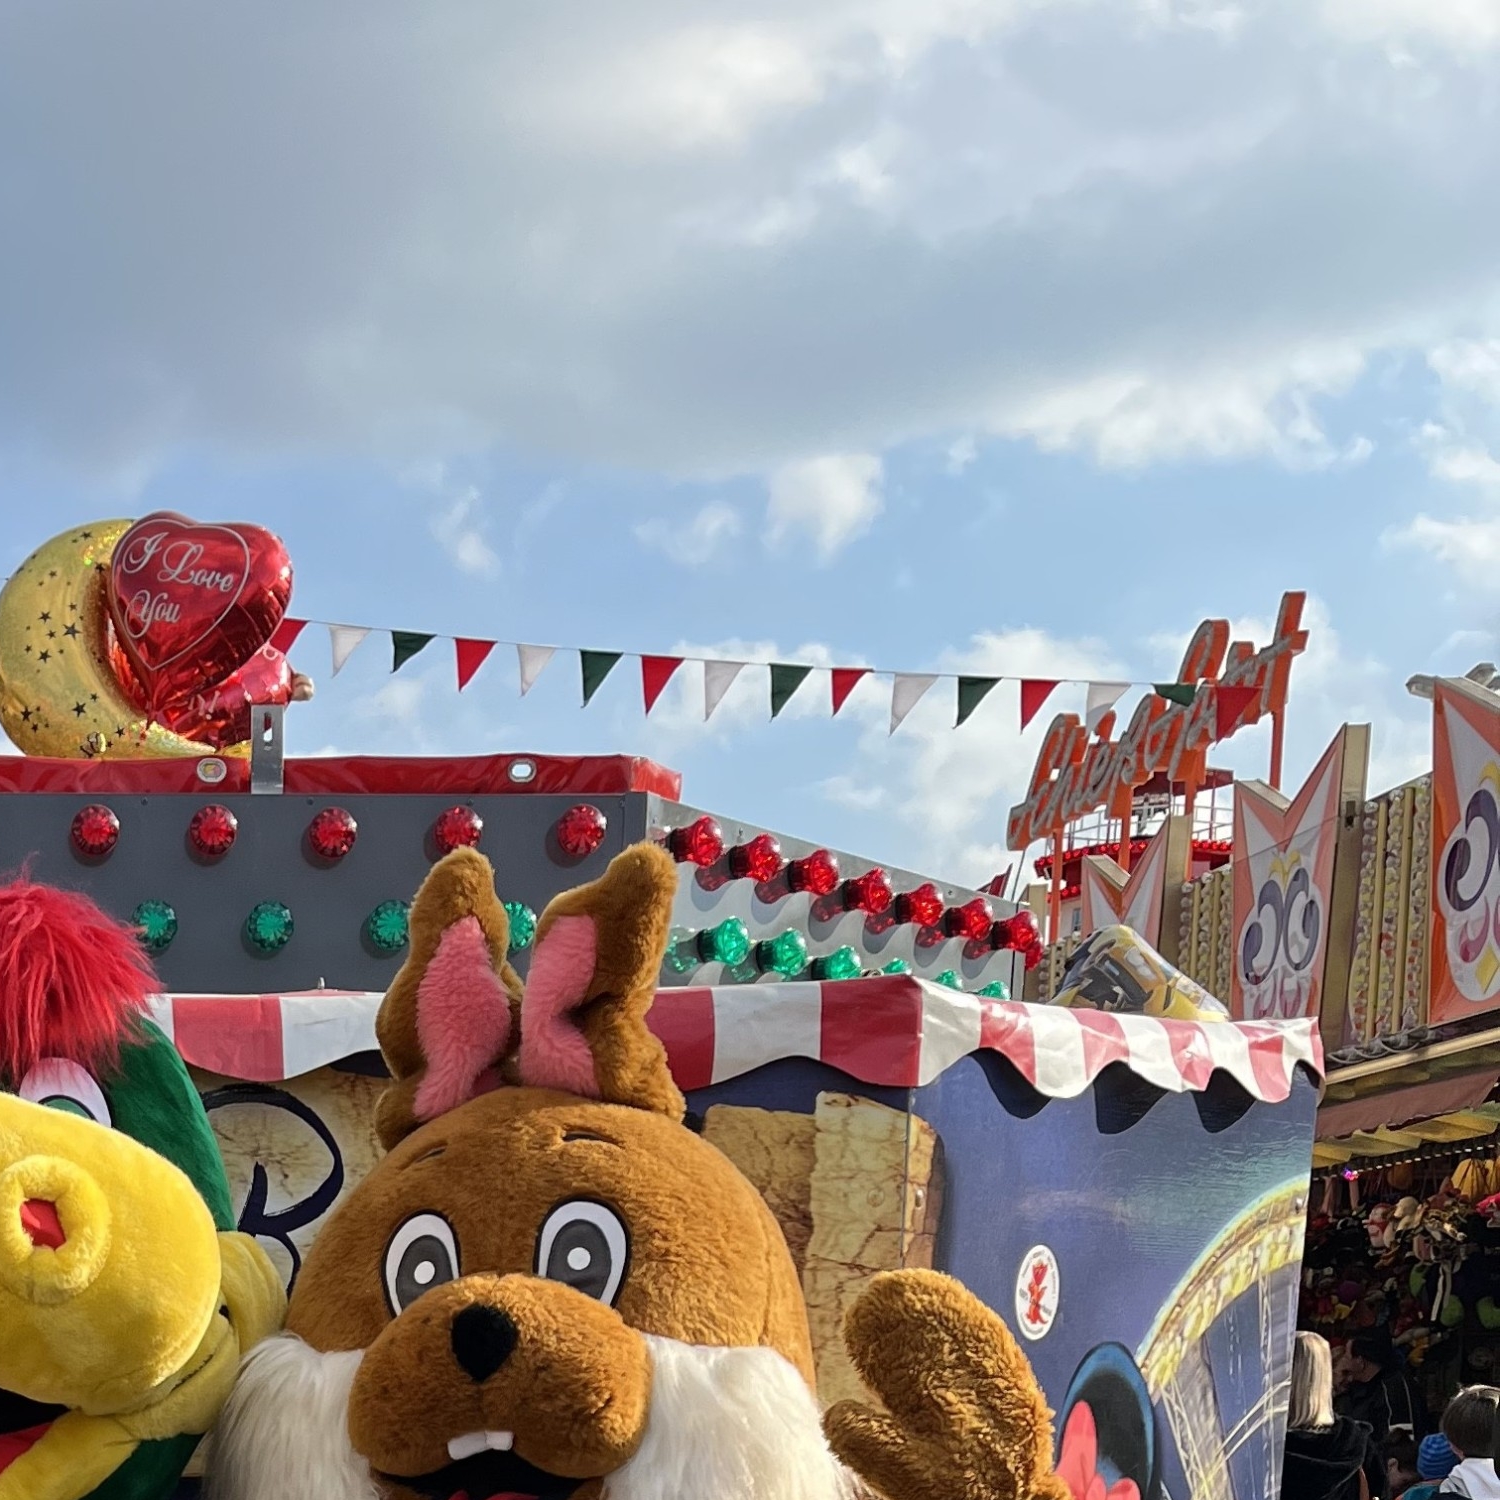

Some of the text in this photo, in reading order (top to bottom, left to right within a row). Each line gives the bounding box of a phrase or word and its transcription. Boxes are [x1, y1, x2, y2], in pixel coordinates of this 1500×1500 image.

[122, 531, 234, 592] I Love
[124, 590, 181, 639] You
